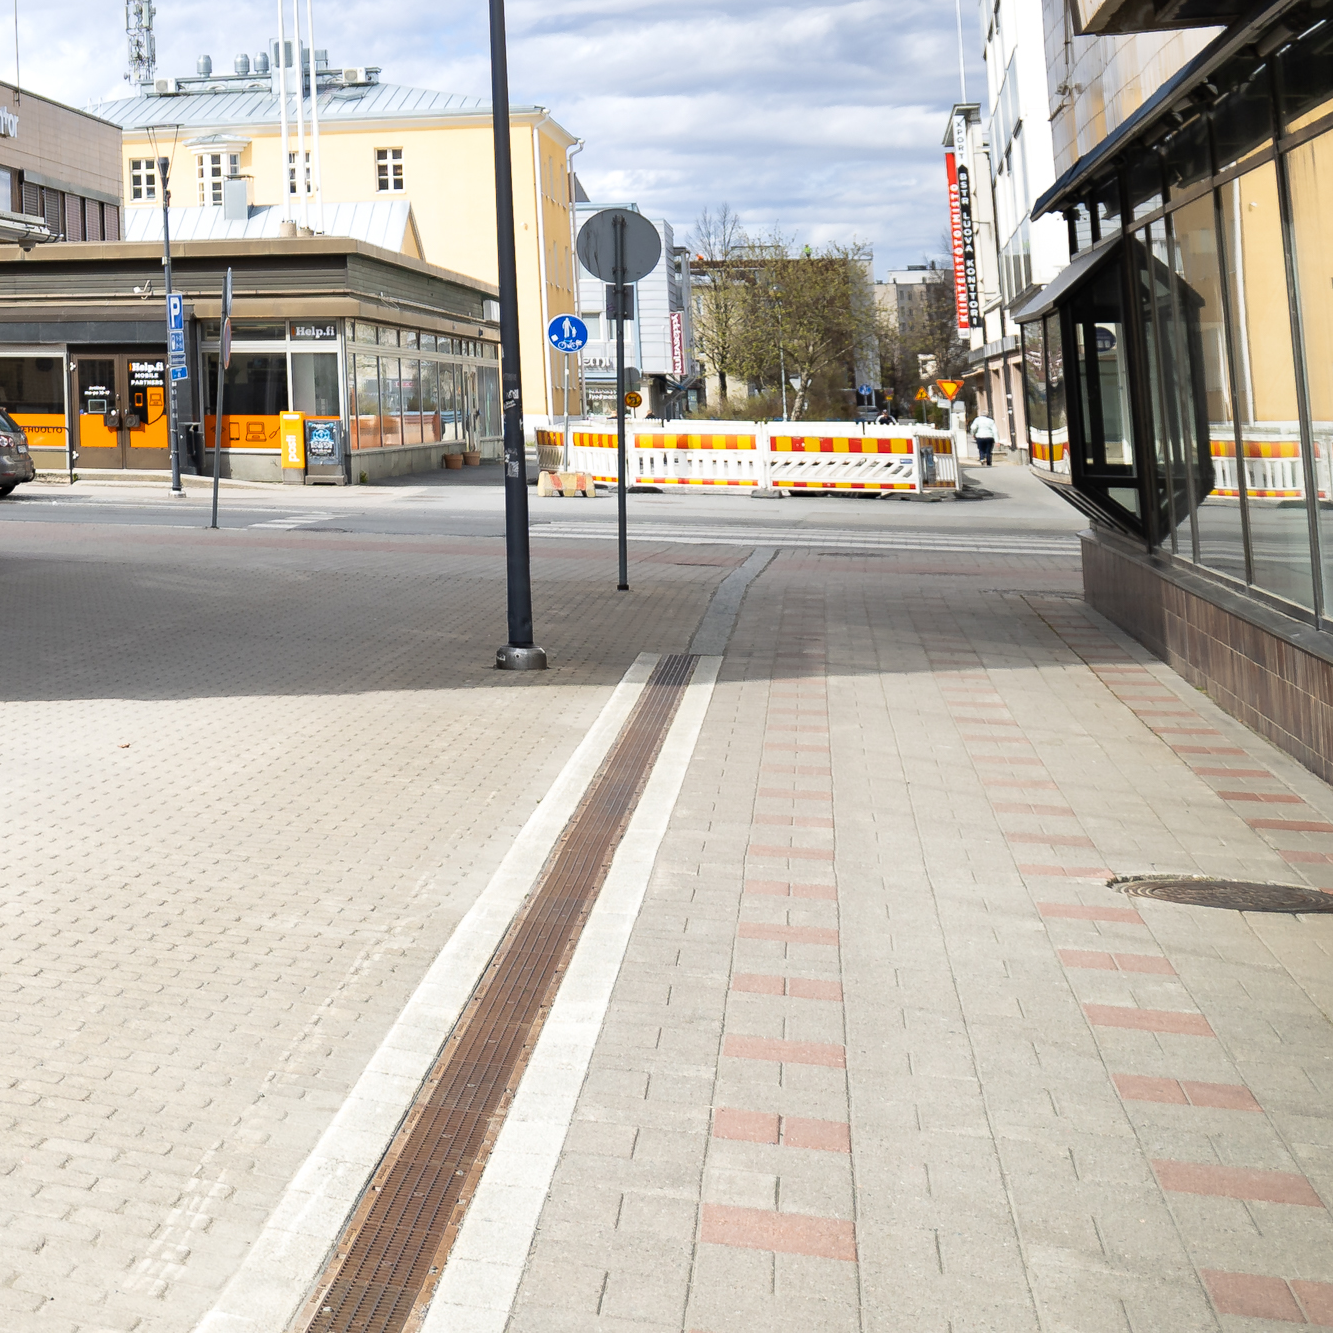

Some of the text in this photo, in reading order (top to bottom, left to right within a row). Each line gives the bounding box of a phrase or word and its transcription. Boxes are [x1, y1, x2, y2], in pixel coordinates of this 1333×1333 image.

[962, 212, 973, 252] LUOVA
[966, 259, 979, 325] KONTTORI
[170, 297, 180, 328] P
[286, 435, 300, 463] posti
